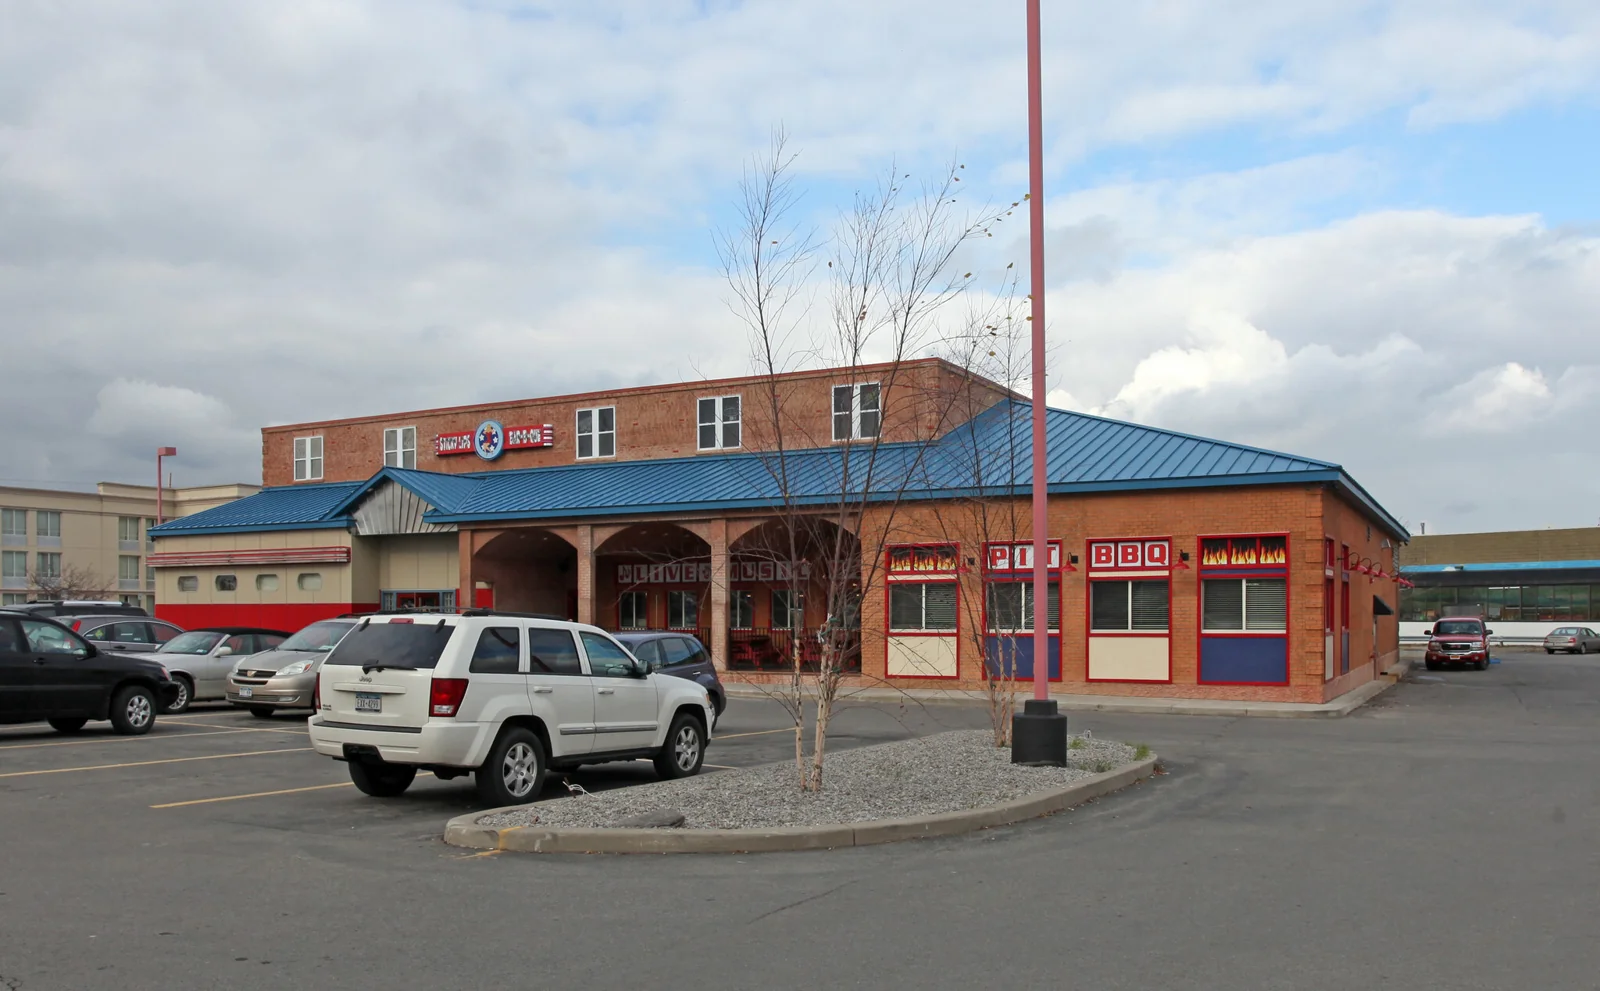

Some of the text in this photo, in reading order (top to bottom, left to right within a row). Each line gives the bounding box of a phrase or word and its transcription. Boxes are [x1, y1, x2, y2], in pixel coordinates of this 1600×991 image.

[989, 543, 1167, 567] PIT BBQ
[636, 565, 694, 581] LIVE
